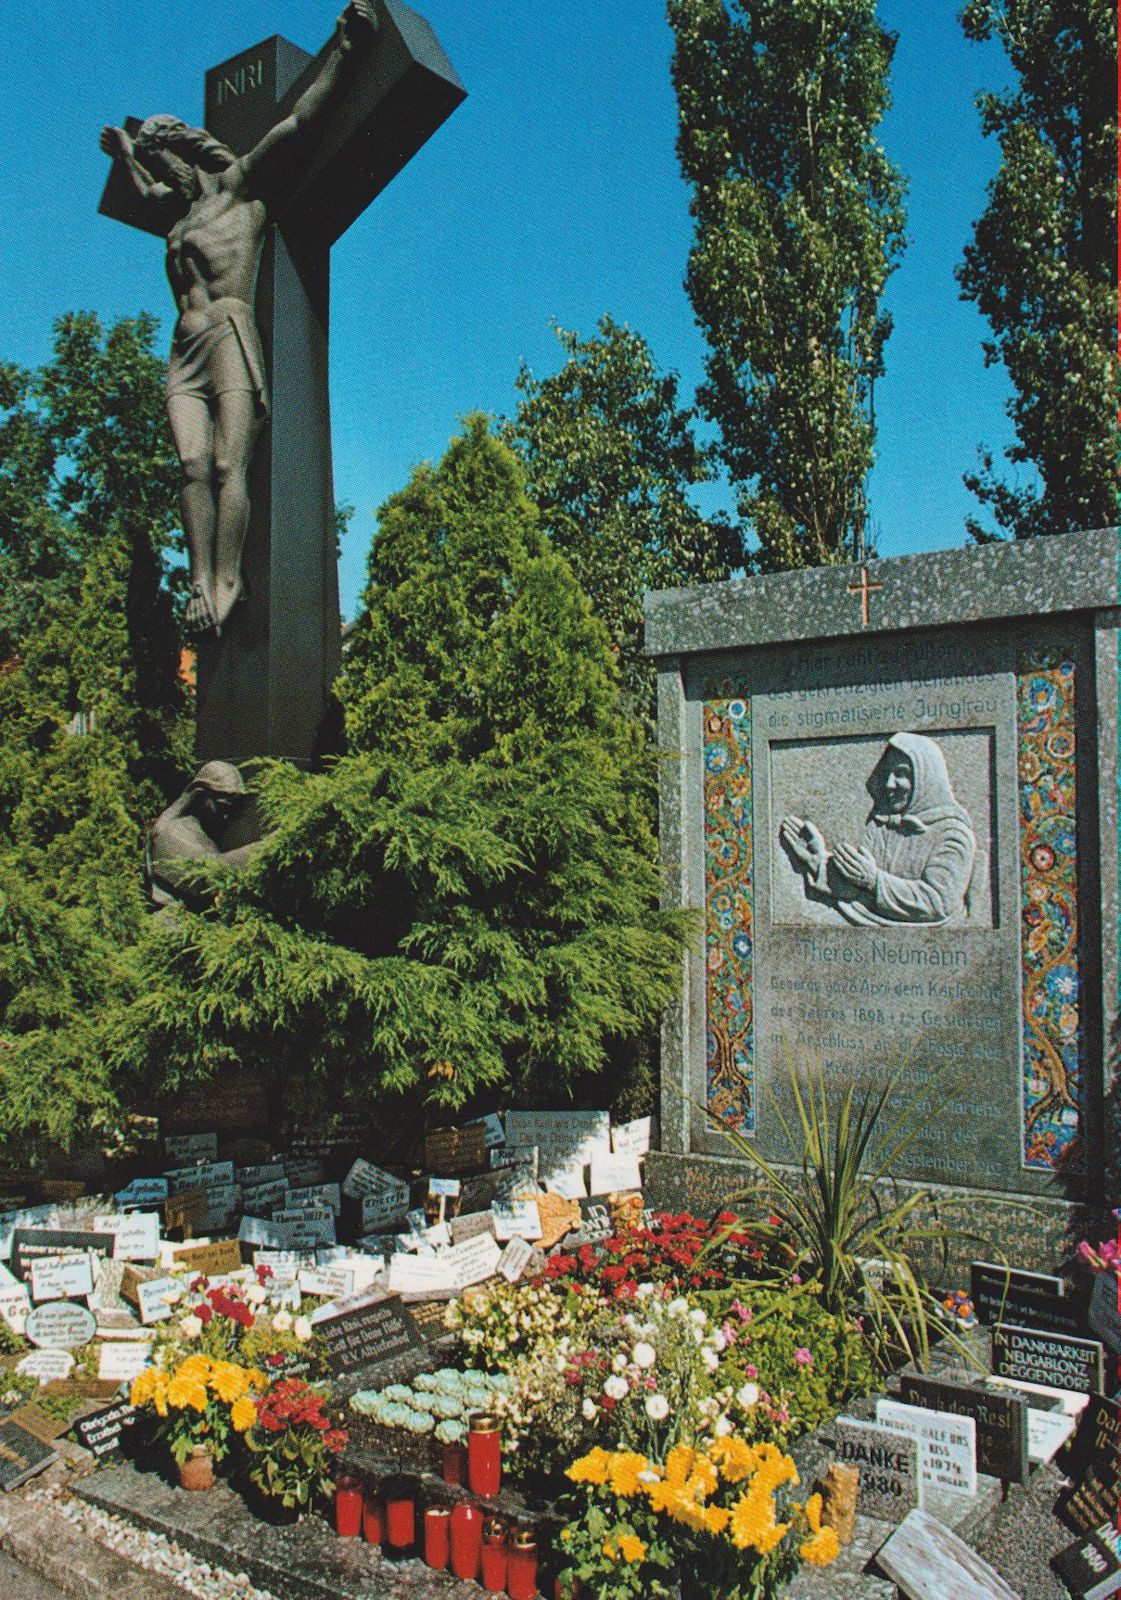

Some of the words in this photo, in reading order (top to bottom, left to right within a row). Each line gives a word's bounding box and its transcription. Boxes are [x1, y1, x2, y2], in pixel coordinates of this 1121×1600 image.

[217, 59, 263, 104] INRI
[768, 710, 789, 728] die
[797, 703, 905, 730] stigmatisierte
[914, 697, 998, 720] Jungfrau
[799, 939, 863, 964] Theres
[871, 942, 968, 967] Neumann
[852, 1006, 885, 1023] 1898
[994, 1332, 1009, 1346] IN
[1011, 1334, 1096, 1363] DANKBARKEIT
[1004, 1348, 1088, 1377] NEUGABLONZ
[998, 1362, 1090, 1390] DEGGENDORF
[842, 1440, 910, 1474] DANKE
